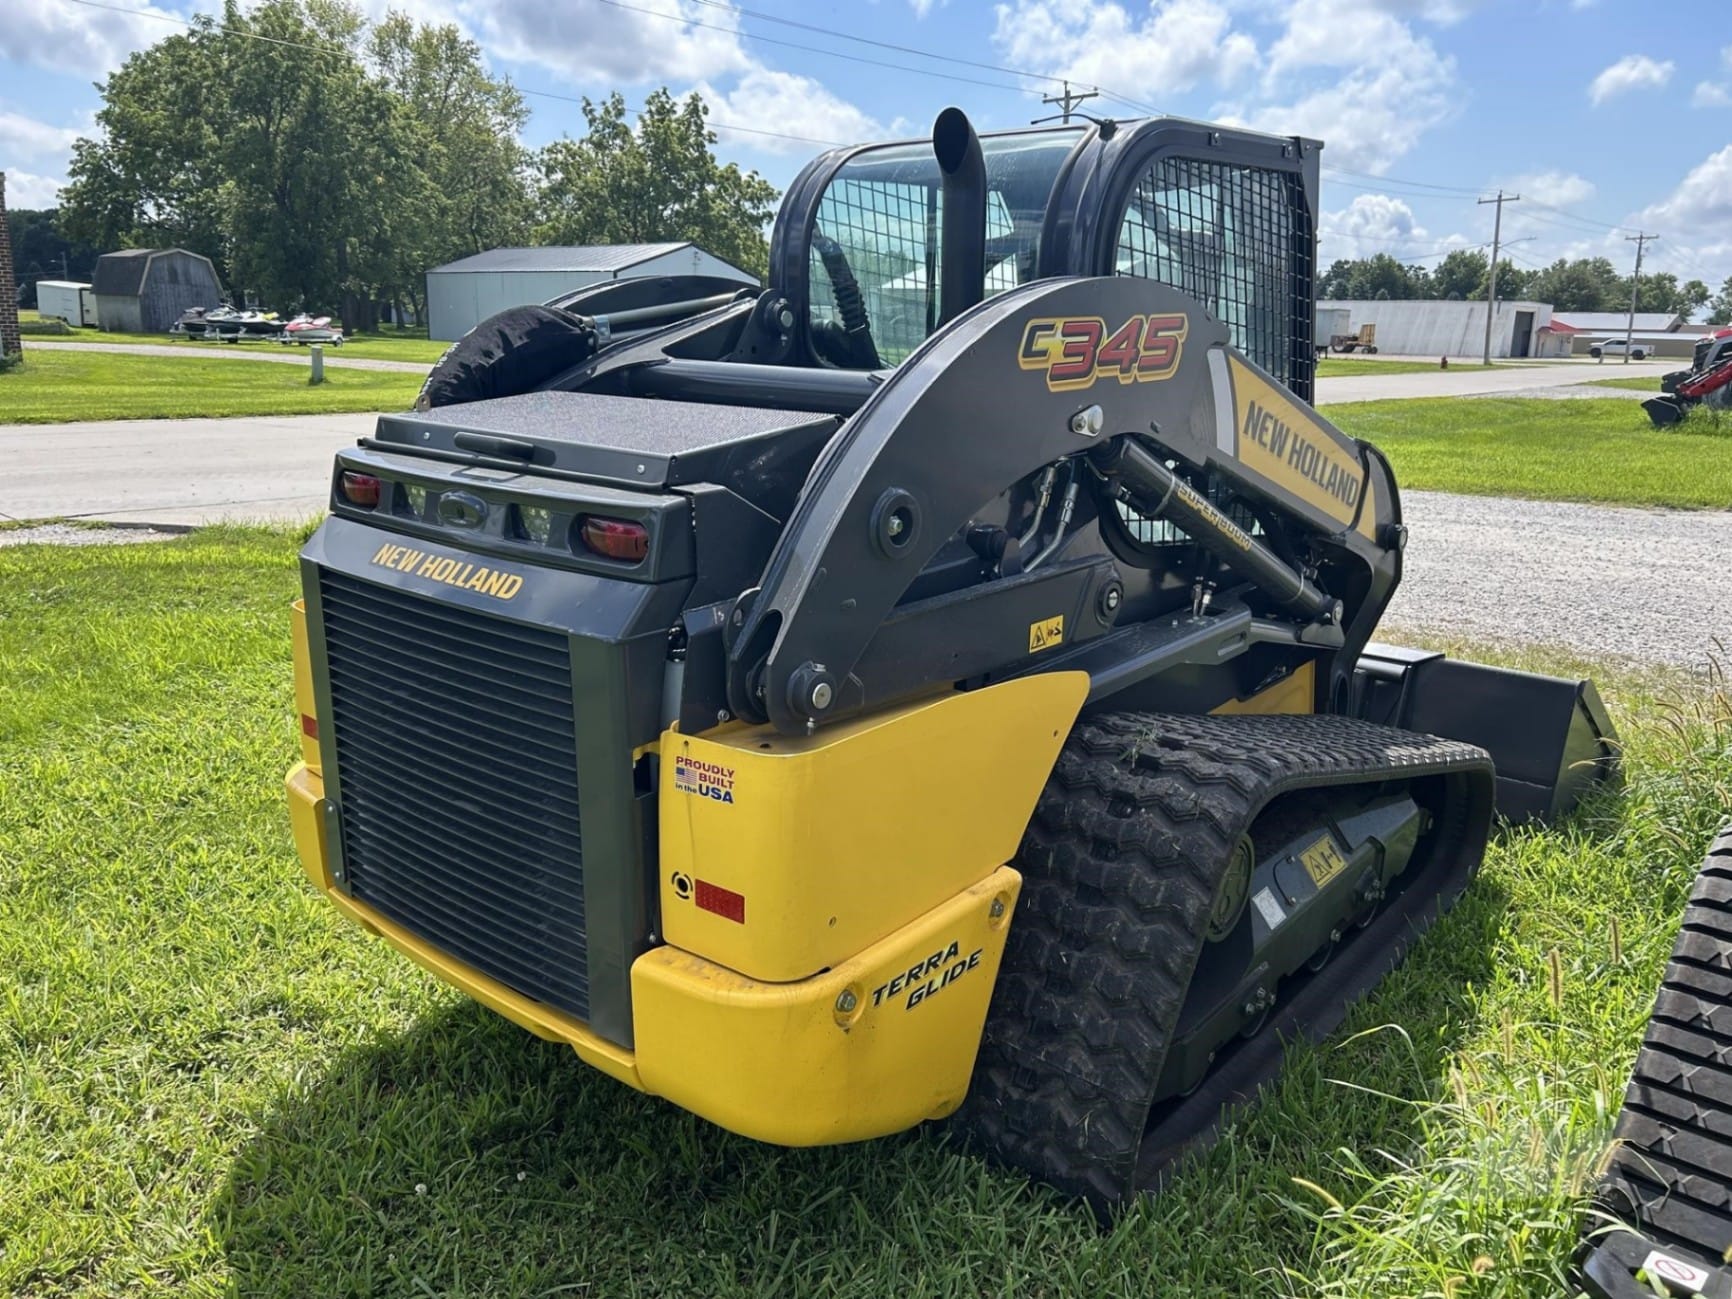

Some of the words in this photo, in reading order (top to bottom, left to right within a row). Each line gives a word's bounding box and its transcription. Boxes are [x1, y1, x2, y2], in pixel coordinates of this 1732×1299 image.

[1019, 313, 1189, 391] C345
[1243, 399, 1291, 459] NEW
[1287, 432, 1360, 508] HOLLAND
[372, 543, 425, 573] NEW
[416, 554, 524, 600] HOLLAND
[675, 782, 684, 790] in
[684, 784, 698, 794] the
[698, 783, 734, 805] USA
[676, 756, 735, 779] PROUDLY
[698, 772, 735, 790] BUILT
[873, 940, 959, 1007] TERRA
[906, 948, 983, 1010] GLIDE
